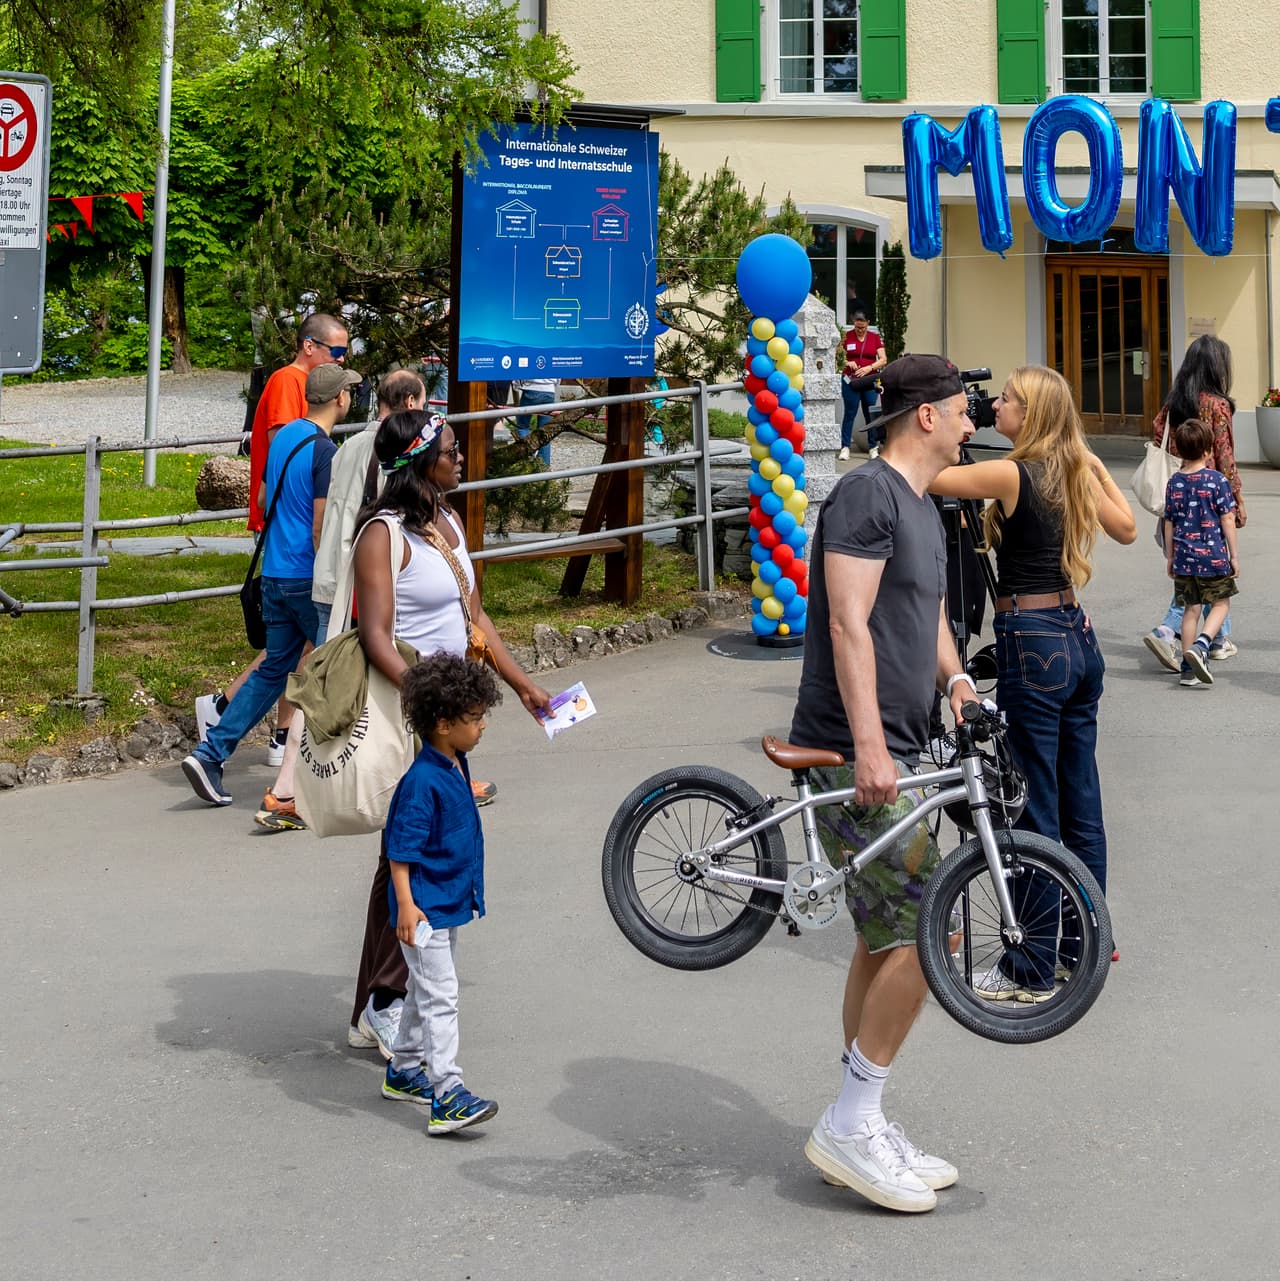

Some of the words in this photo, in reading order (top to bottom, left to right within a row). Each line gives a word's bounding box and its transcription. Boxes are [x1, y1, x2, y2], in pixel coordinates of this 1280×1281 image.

[506, 138, 577, 154] Internationale
[578, 143, 628, 157] Schweizer
[499, 155, 534, 169] Tages-
[536, 158, 556, 169] und
[558, 158, 633, 173] Internatsschule
[6, 174, 33, 187] Sonntag
[0, 200, 18, 210] 18.00
[19, 200, 31, 210] Uhr
[337, 742, 359, 768] THE
[311, 760, 339, 779] THREE
